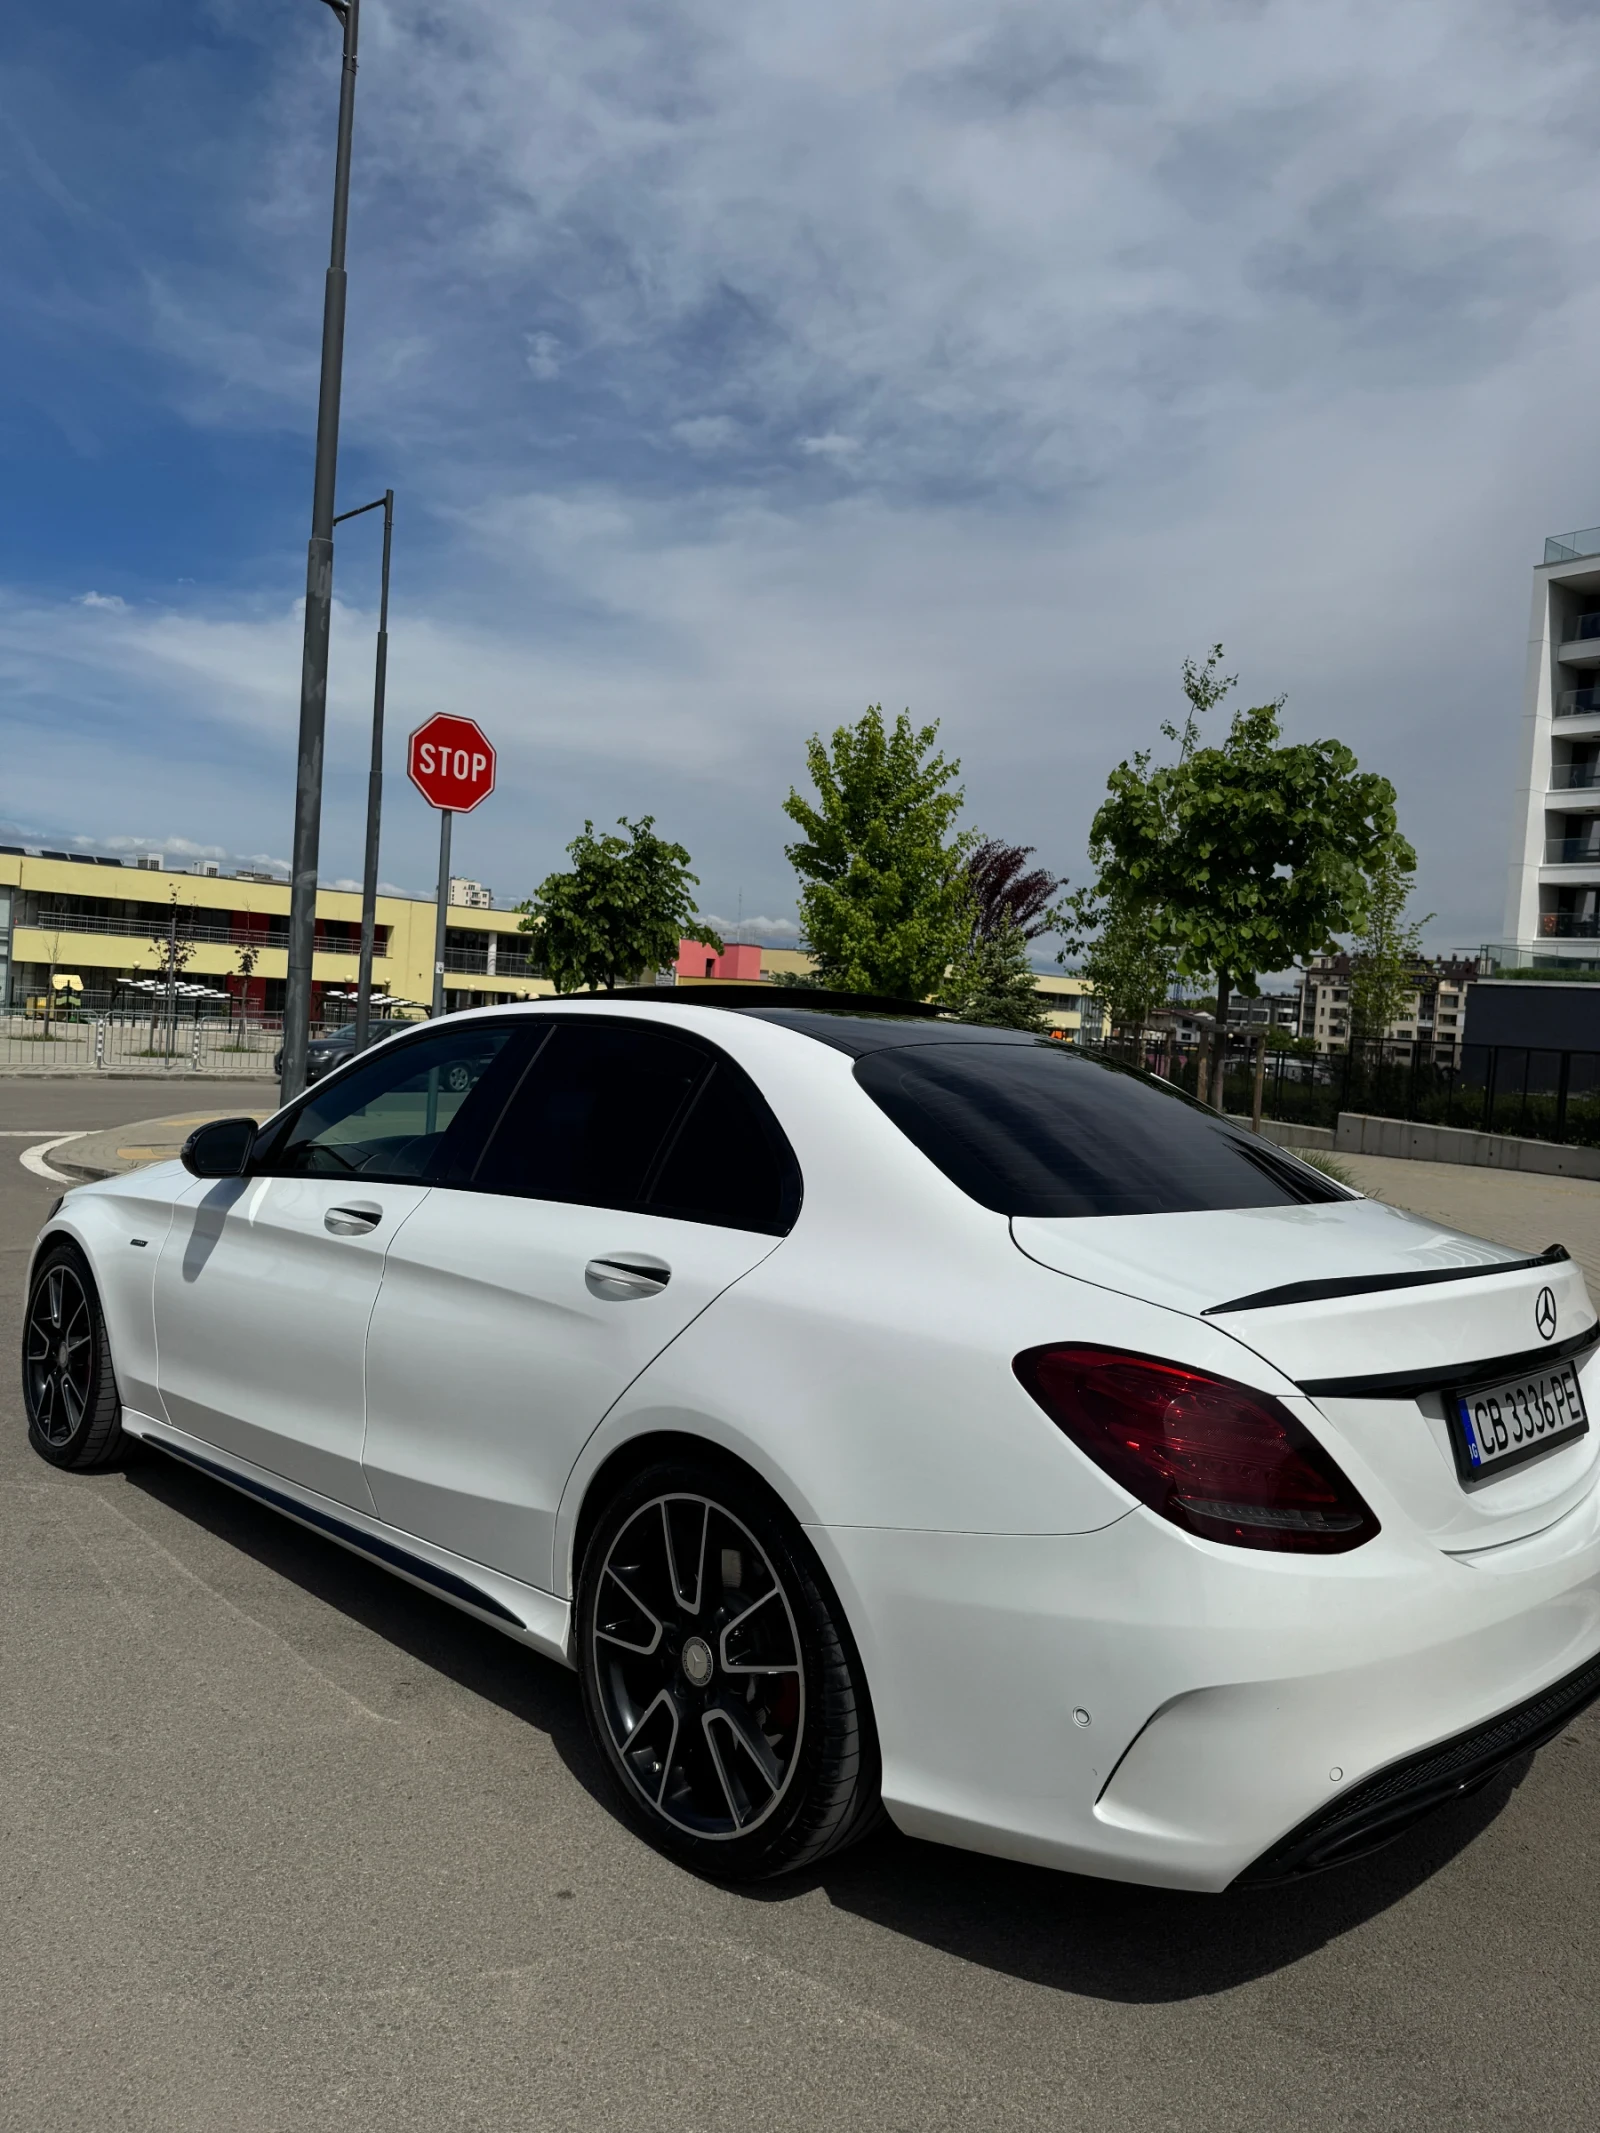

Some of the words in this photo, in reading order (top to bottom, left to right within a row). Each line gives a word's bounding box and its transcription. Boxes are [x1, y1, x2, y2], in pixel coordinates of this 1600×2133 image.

[419, 743, 487, 782] STOP
[1474, 1397, 1509, 1455] CB
[1504, 1380, 1556, 1443] 3336
[1549, 1371, 1581, 1425] PE
